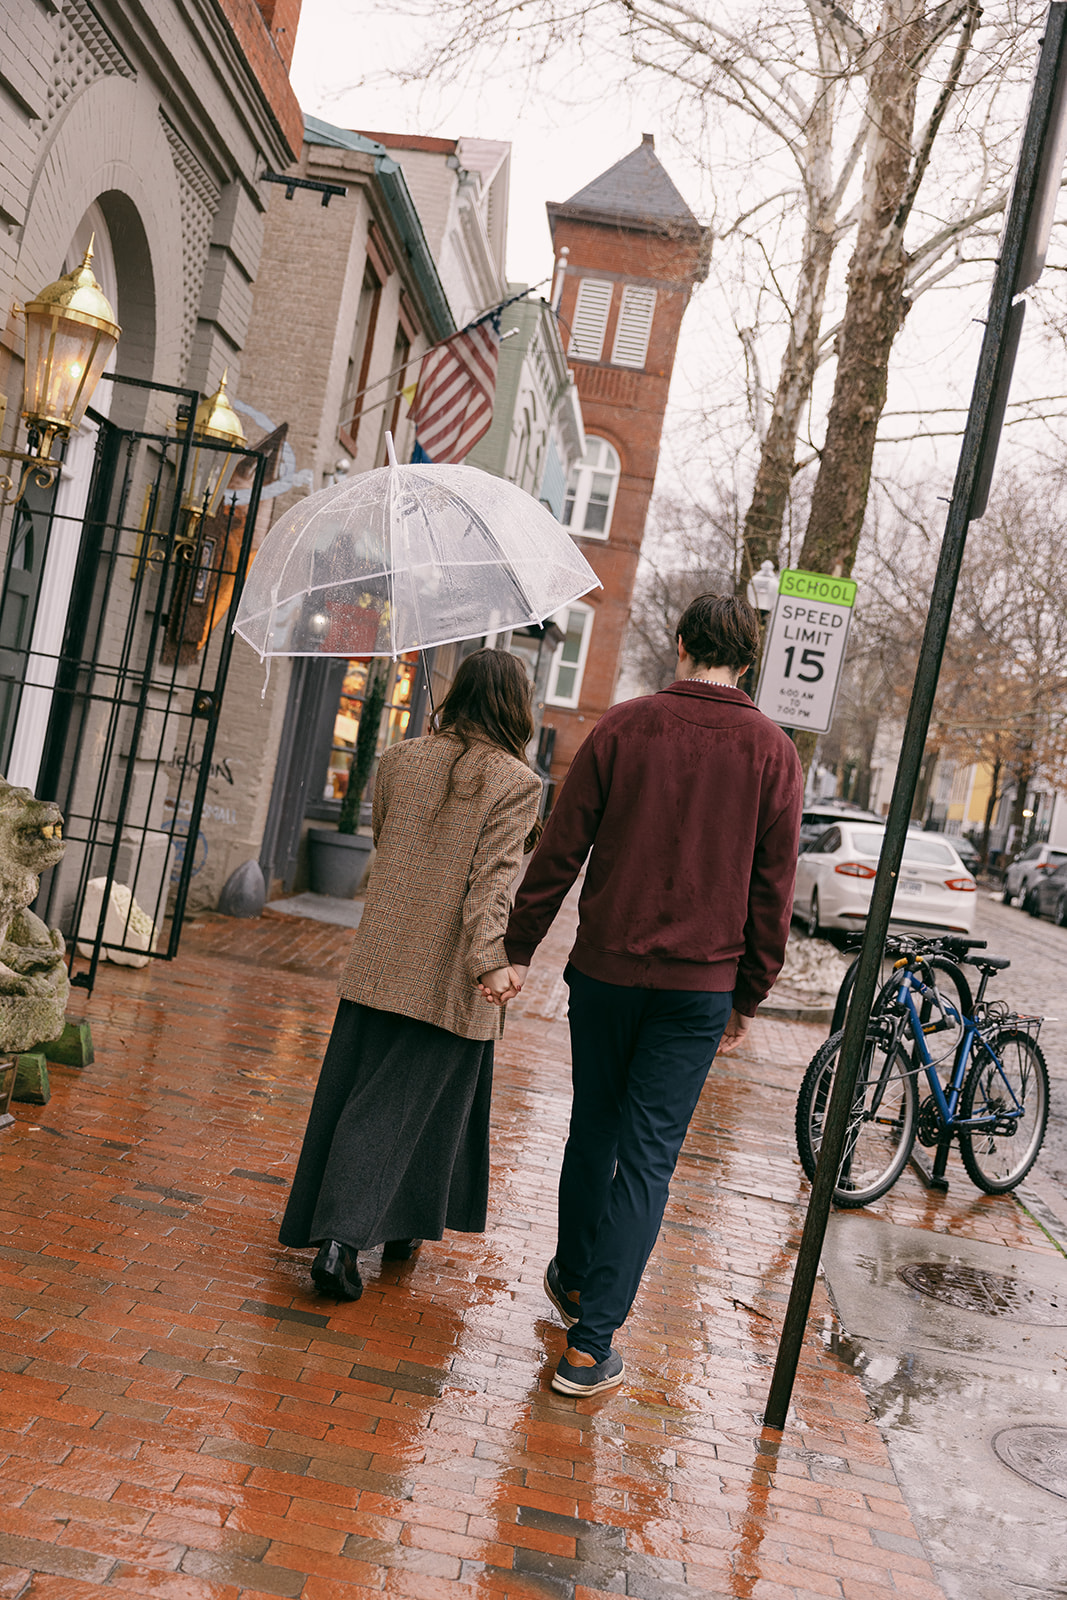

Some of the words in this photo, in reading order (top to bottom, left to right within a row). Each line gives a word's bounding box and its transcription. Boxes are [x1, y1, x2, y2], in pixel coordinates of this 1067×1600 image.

[784, 576, 851, 602] SCHOOL
[781, 605, 843, 628] SPEED
[783, 625, 833, 646] LIMIT
[784, 645, 825, 684] 15
[790, 698, 801, 707] TO
[801, 692, 814, 700] AM
[798, 709, 810, 717] PM
